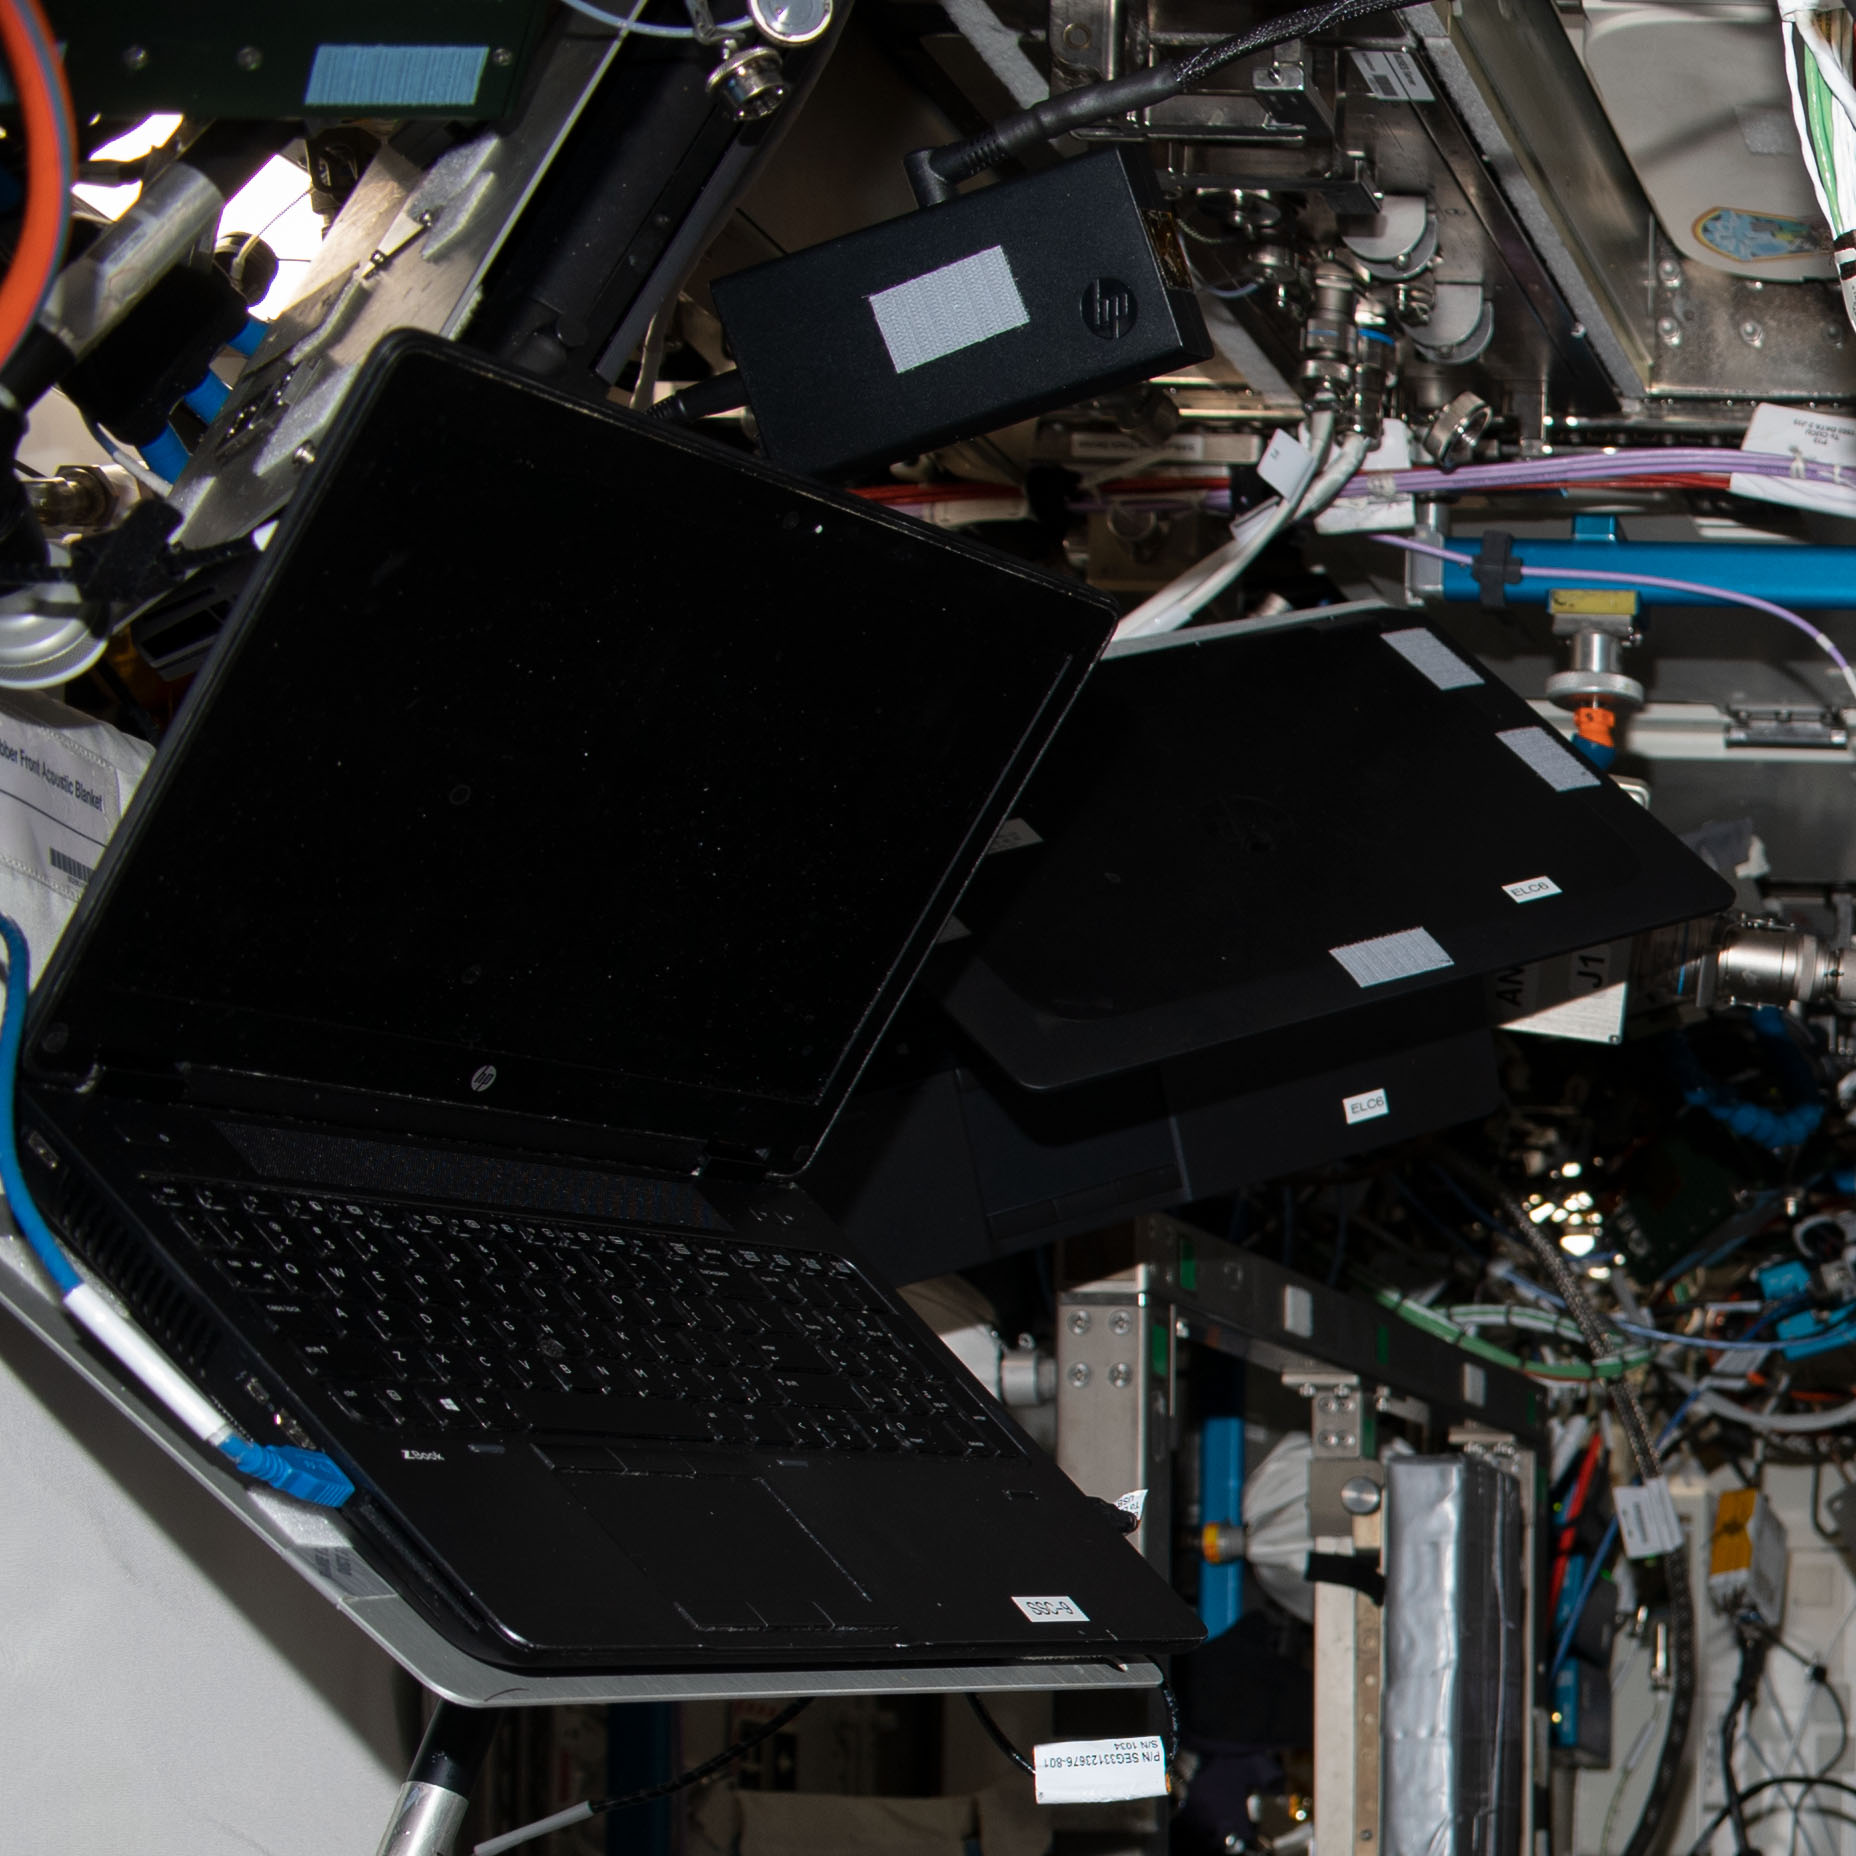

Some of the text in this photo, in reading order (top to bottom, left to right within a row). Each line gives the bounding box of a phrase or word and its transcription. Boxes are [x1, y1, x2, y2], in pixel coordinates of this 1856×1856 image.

[75, 778, 103, 811] Blanket
[1510, 880, 1549, 898] ELC6
[1574, 954, 1605, 989] J1
[1349, 1097, 1384, 1114] ELC6
[1025, 1599, 1073, 1616] SSC-9
[1113, 1740, 1157, 1750] S/N 1034
[1043, 1751, 1159, 1767] P/N SEG33123676-801
